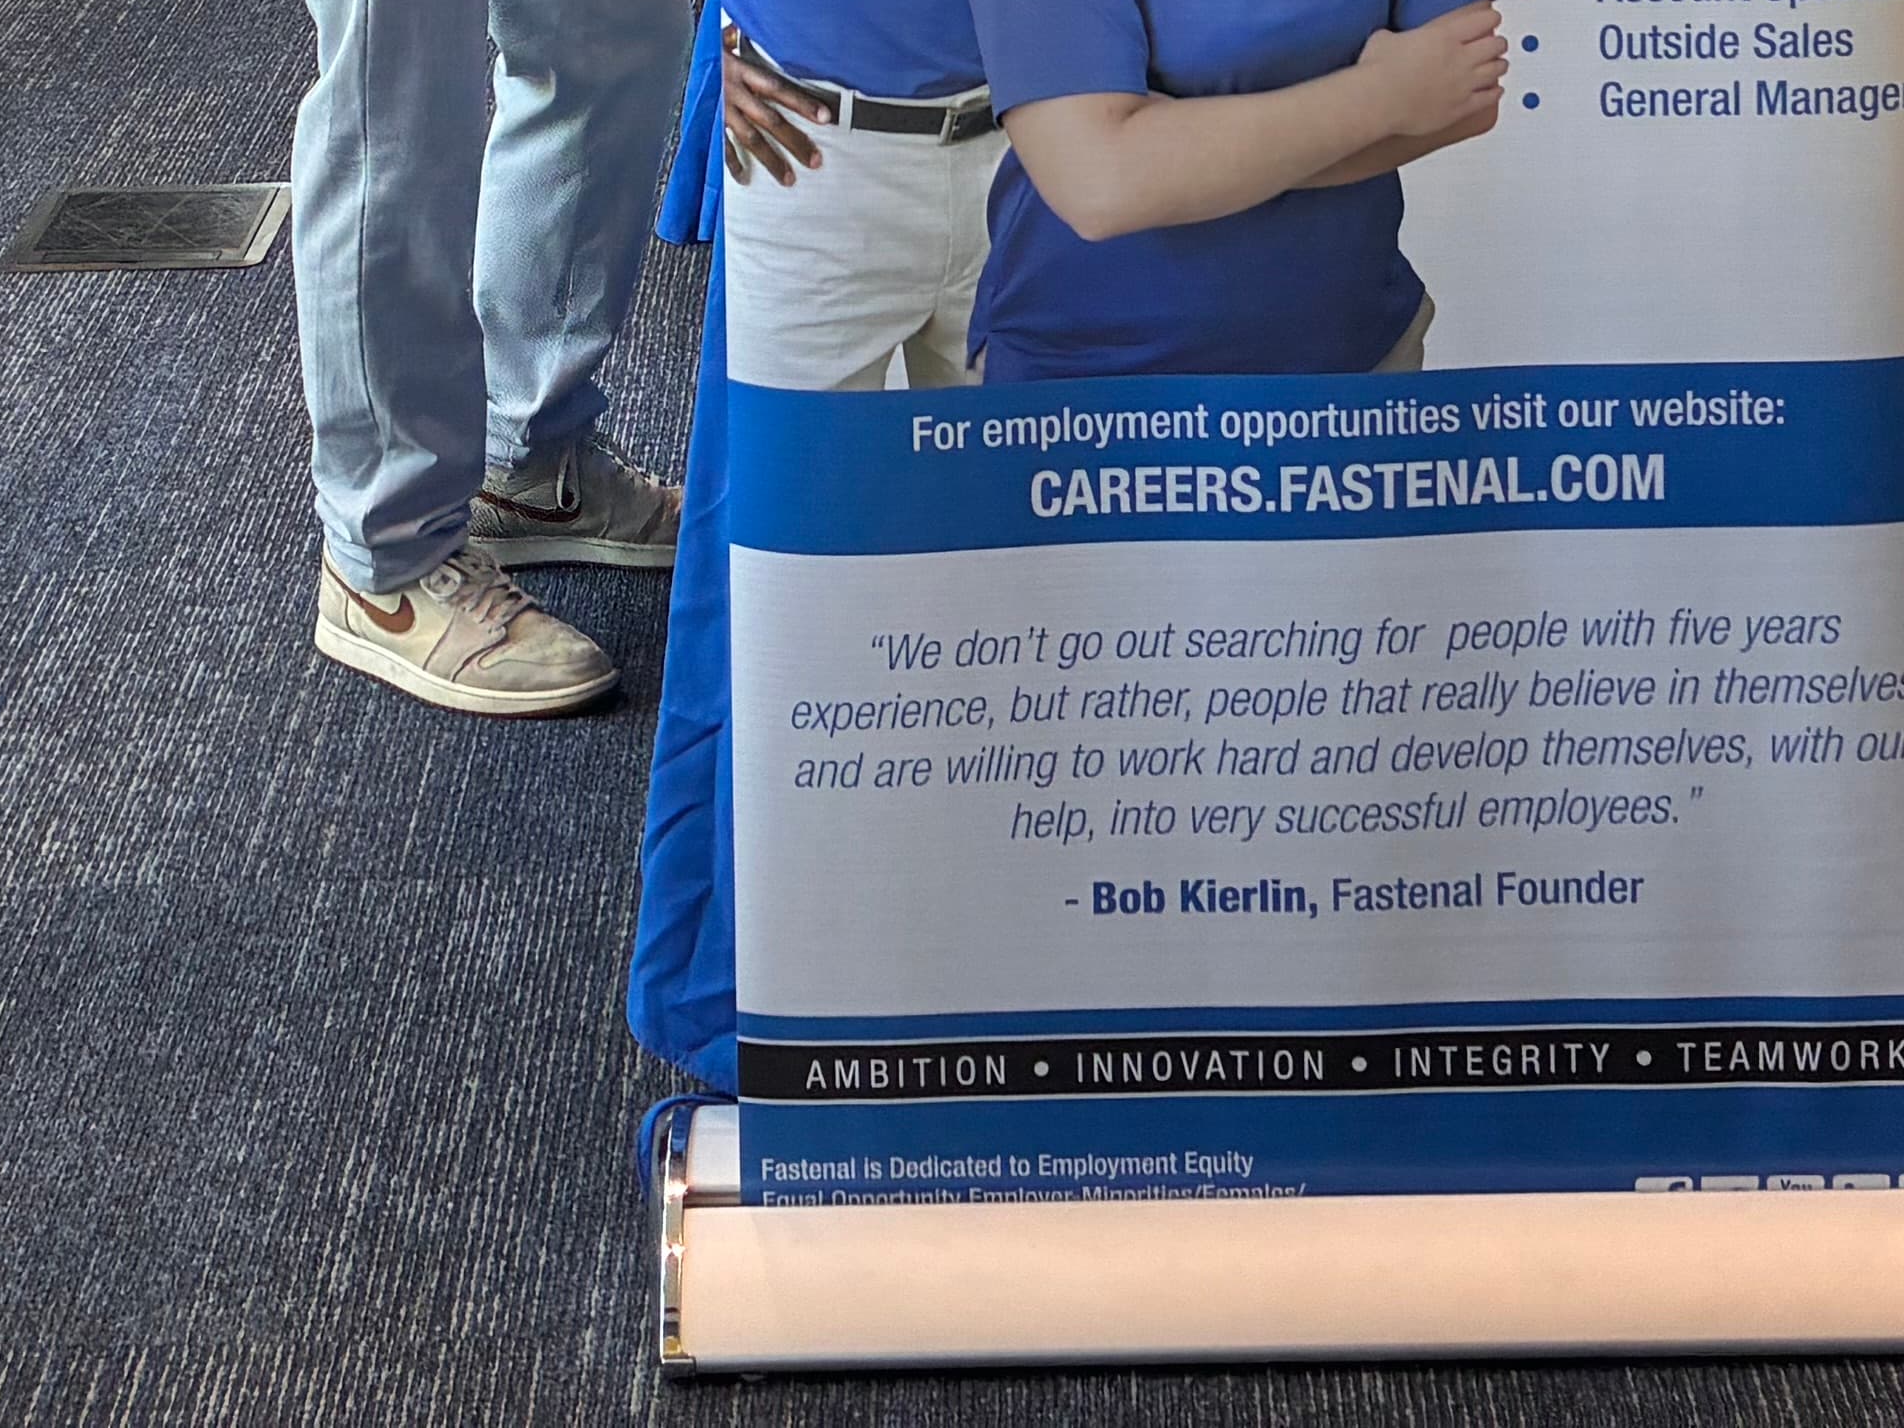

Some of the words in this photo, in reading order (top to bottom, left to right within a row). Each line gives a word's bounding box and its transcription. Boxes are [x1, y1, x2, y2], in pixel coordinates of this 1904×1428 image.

[1599, 23, 1741, 61] Outside
[1753, 21, 1854, 59] Sales
[1599, 80, 1741, 119] General
[912, 414, 971, 452] For
[982, 403, 1210, 453] employment
[1220, 396, 1460, 447] opportunities
[1472, 393, 1547, 432] visit
[1557, 398, 1619, 429] our
[1630, 389, 1786, 429] website:
[1030, 452, 1666, 517] CAREERS.FASTENAL.COM
[955, 625, 1051, 666] don't
[1058, 630, 1103, 670] go
[1115, 622, 1176, 660] out
[1185, 620, 1363, 665] searching
[1375, 617, 1427, 657] for
[1446, 609, 1568, 660] people
[1582, 607, 1655, 647] with
[1668, 607, 1731, 646] five
[1739, 610, 1842, 654] years
[791, 693, 996, 739] experience,
[1010, 685, 1070, 725] but
[1080, 681, 1193, 723] rather,
[1204, 679, 1327, 726] people
[1342, 676, 1413, 715] that
[1421, 670, 1519, 717] really
[1528, 669, 1655, 709] believe
[1668, 668, 1700, 706] in
[794, 752, 863, 789] and
[873, 756, 932, 787] are
[946, 744, 1059, 787] willing
[1071, 743, 1105, 780] to
[1118, 739, 1204, 778] work
[1216, 738, 1298, 776] hard
[1309, 735, 1380, 774] and
[1391, 729, 1529, 775] develop
[1542, 727, 1753, 771] themselves,
[1769, 725, 1844, 765] with
[1010, 801, 1095, 846] help,
[1110, 799, 1176, 838] into
[1190, 803, 1265, 842] very
[1275, 790, 1468, 835] successful
[1092, 881, 1166, 915] Bob
[1179, 878, 1318, 919] Kierlin,
[1331, 872, 1483, 911] Fastenal
[1496, 869, 1645, 907] Founder
[805, 1055, 1008, 1090] AMBITION
[1076, 1049, 1326, 1084] INNOVATION
[1394, 1043, 1610, 1079] INTEGRITY
[761, 1157, 856, 1181] Fastenal
[890, 1154, 1001, 1179] Dedicated
[1009, 1155, 1030, 1177] to
[1038, 1152, 1178, 1180] Employment
[1184, 1150, 1254, 1178] Equity
